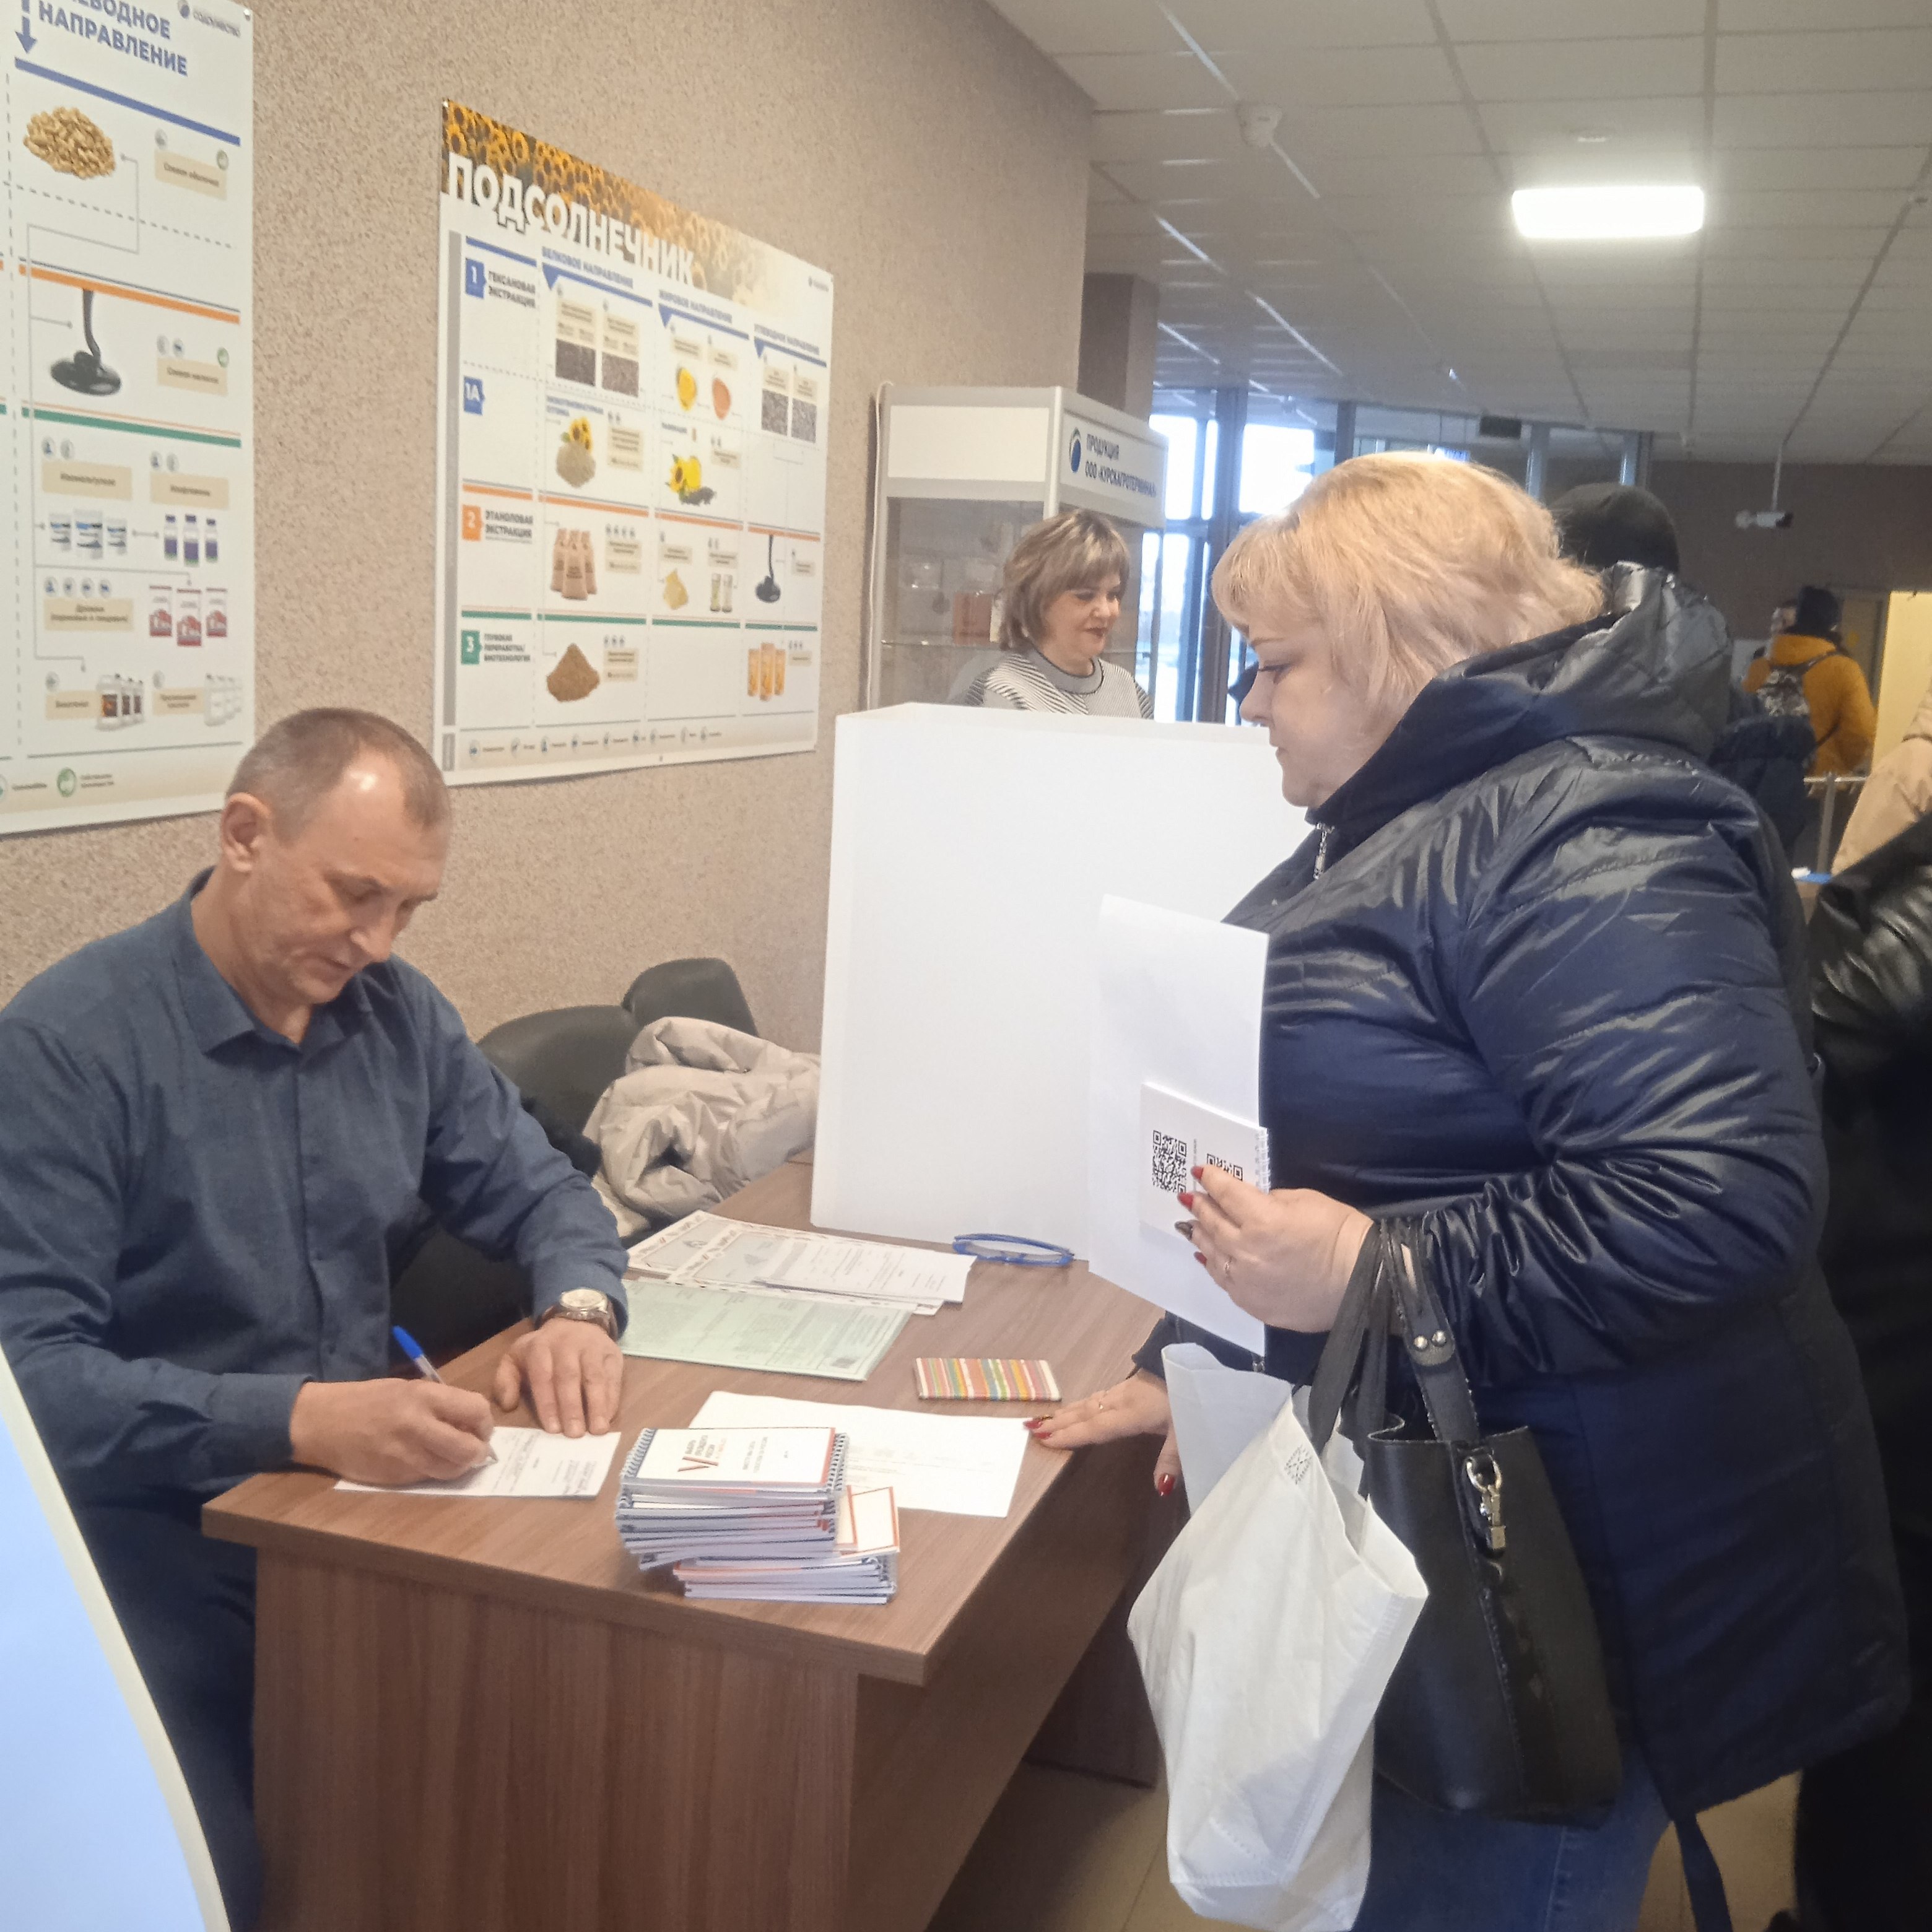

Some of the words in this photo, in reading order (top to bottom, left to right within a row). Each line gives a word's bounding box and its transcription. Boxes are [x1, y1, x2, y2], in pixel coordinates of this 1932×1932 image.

[39, 1, 188, 77] НАПРАВЛЕНИЕ
[448, 152, 694, 287] ПОДСОЛНЕЧНИК
[471, 266, 477, 284] 1
[468, 510, 476, 528] 2
[466, 635, 474, 653] 3
